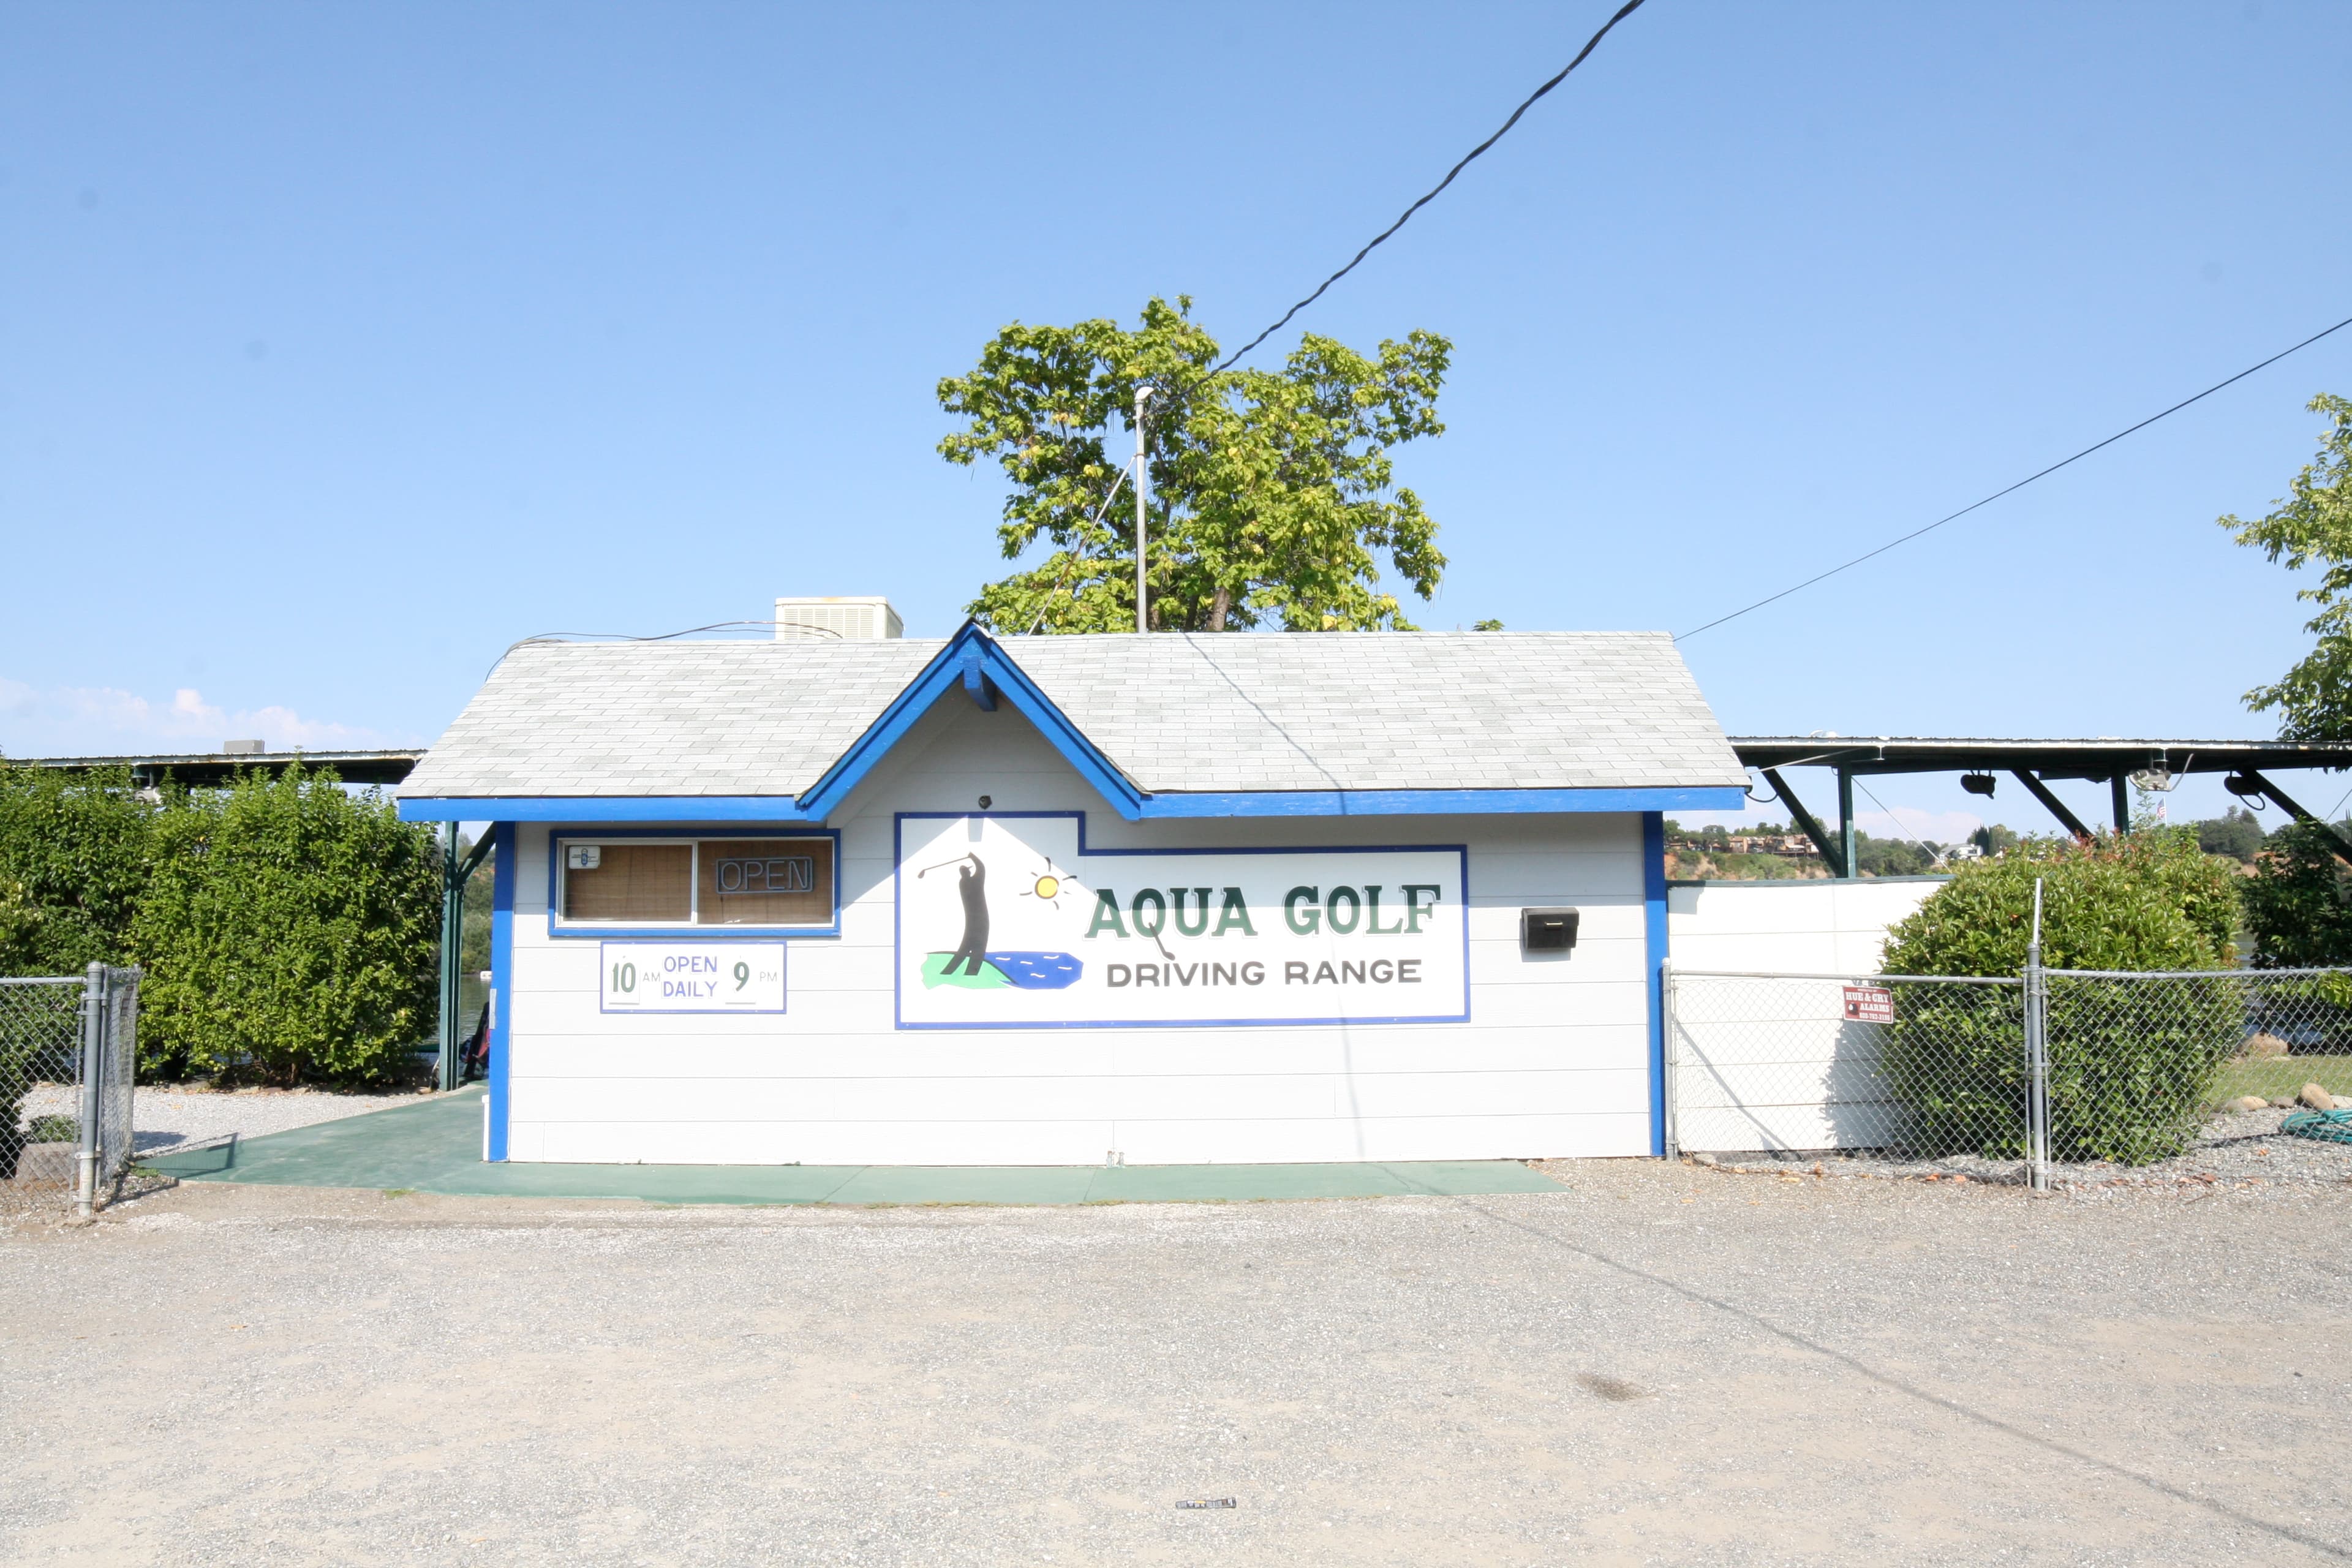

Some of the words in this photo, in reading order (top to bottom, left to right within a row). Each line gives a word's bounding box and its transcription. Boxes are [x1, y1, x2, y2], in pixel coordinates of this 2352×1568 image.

[721, 860, 807, 890] OPEN
[1084, 886, 1258, 959] AQUA
[1281, 884, 1441, 936] GOLF
[612, 962, 636, 993] 10
[642, 972, 661, 982] AM
[663, 956, 718, 973] OPEN
[733, 961, 750, 992] 9
[760, 971, 778, 982] PM
[1106, 961, 1265, 988] DRIVING
[1284, 959, 1422, 985] RANGE
[663, 981, 718, 997] DAILY
[1845, 991, 1863, 1001] HUE
[1864, 992, 1871, 1002] &
[1872, 993, 1889, 1003] CRY
[1860, 1003, 1890, 1013] ALARMS
